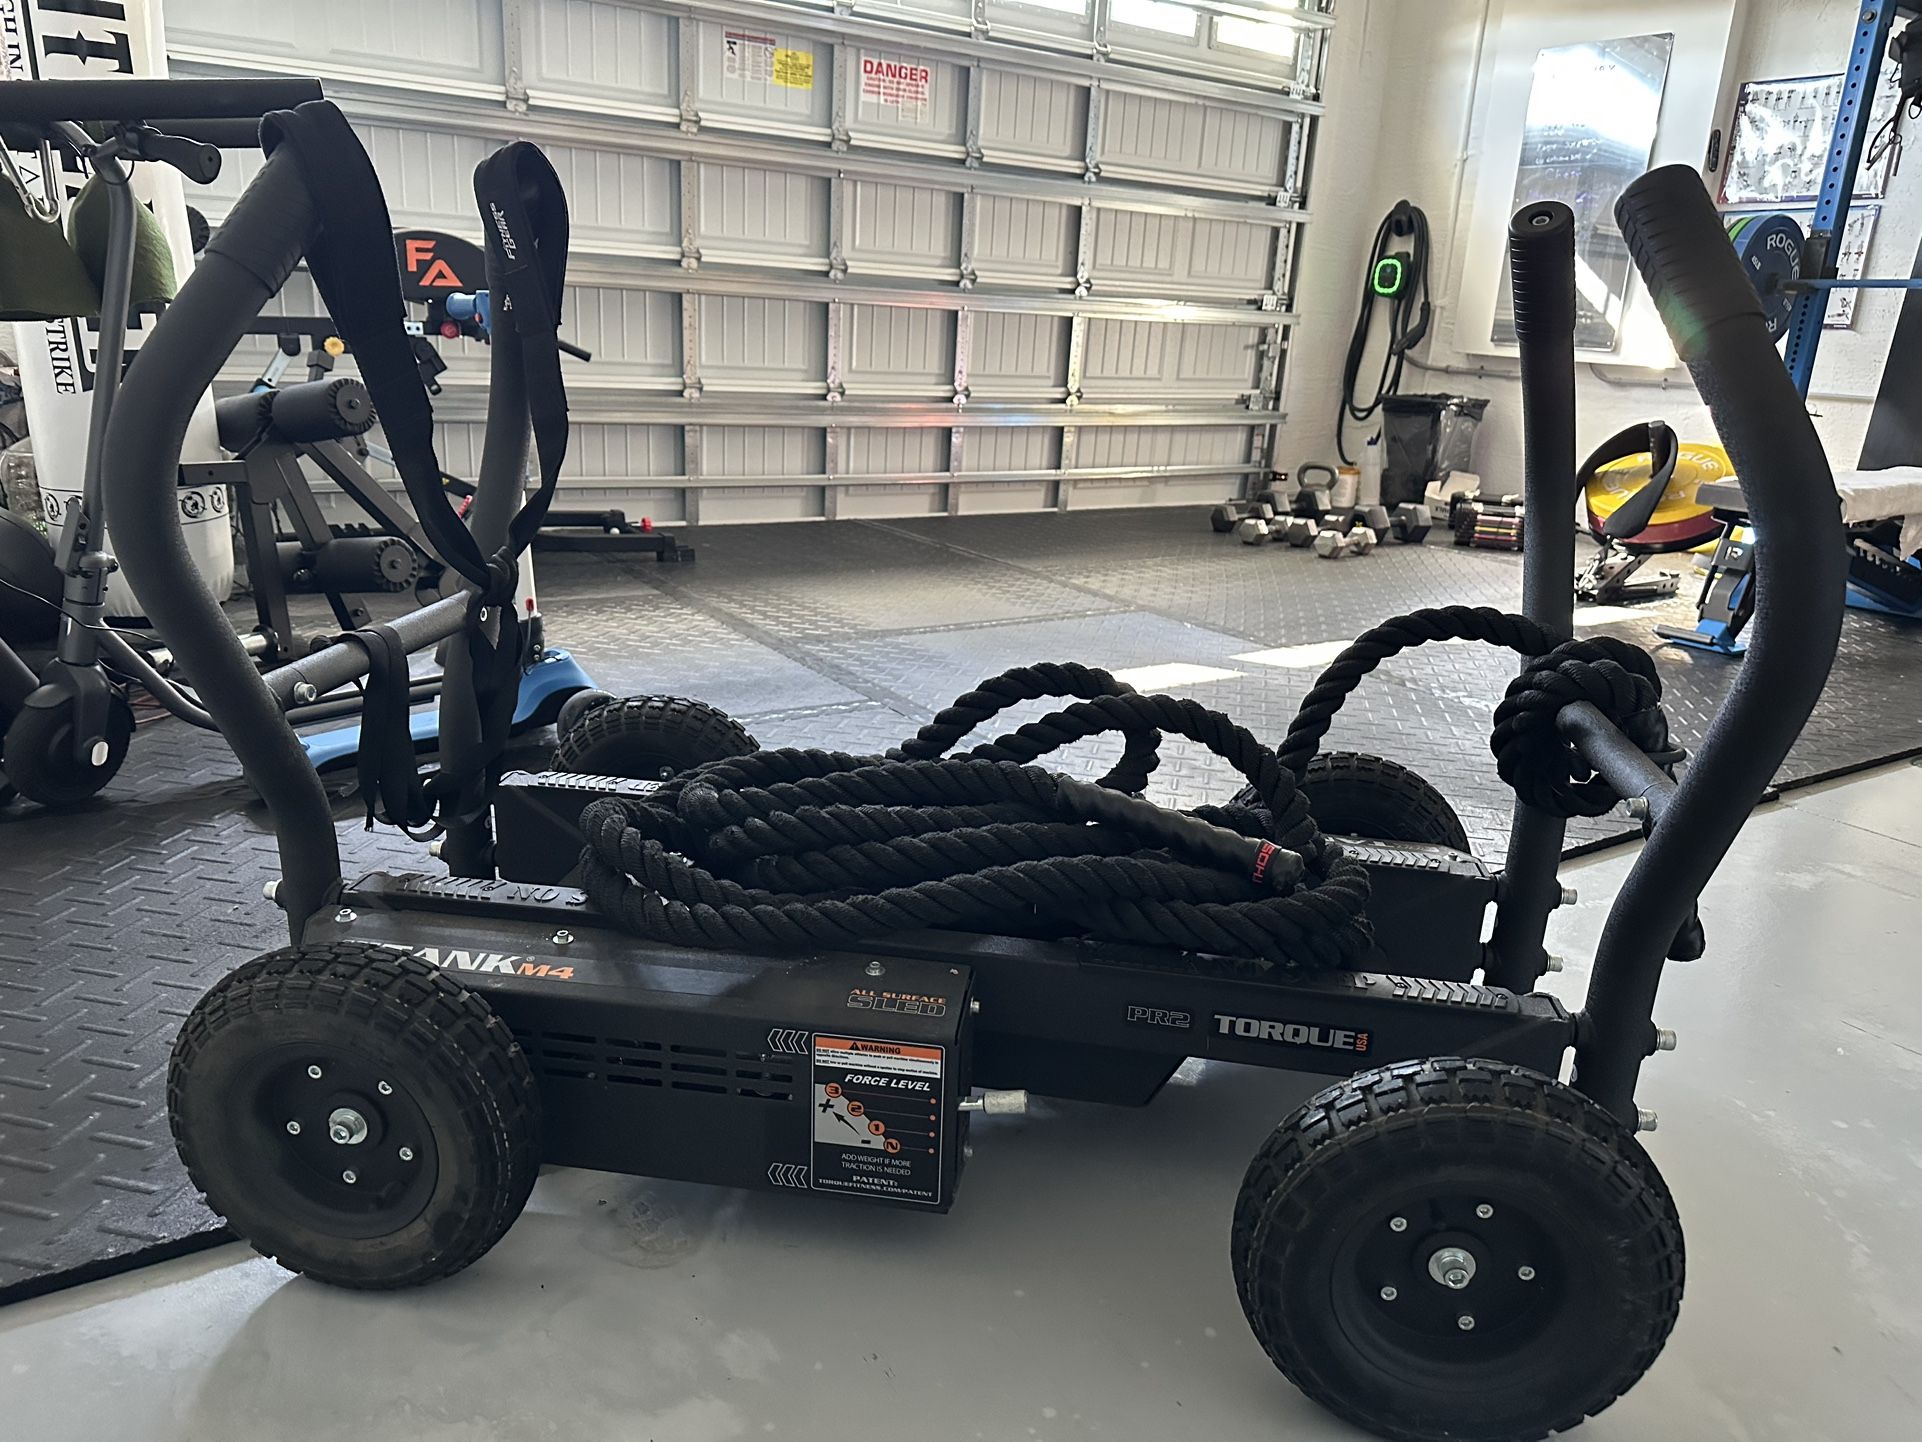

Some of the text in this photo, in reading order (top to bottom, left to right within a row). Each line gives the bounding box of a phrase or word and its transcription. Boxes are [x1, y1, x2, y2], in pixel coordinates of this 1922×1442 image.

[863, 59, 929, 84] DANGER
[1767, 233, 1800, 281] ROGUE
[515, 962, 575, 979] M4
[850, 988, 946, 1004] ALL SURFACE
[847, 994, 947, 1017] SLED
[1127, 1005, 1191, 1028] PR2
[1214, 1014, 1356, 1050] TORQUE
[860, 1043, 902, 1055] WARNING
[1355, 1032, 1370, 1051] USA
[828, 1085, 840, 1095] 3
[844, 1073, 931, 1092] FORCE LEVEL
[849, 1103, 862, 1113] 2
[841, 1153, 857, 1161] ADD
[857, 1155, 883, 1164] WEIGHT
[891, 1159, 912, 1168] MORE
[841, 1161, 876, 1172] TRACTION
[884, 1167, 912, 1176] NEEDED
[852, 1175, 899, 1187] PATENT:
